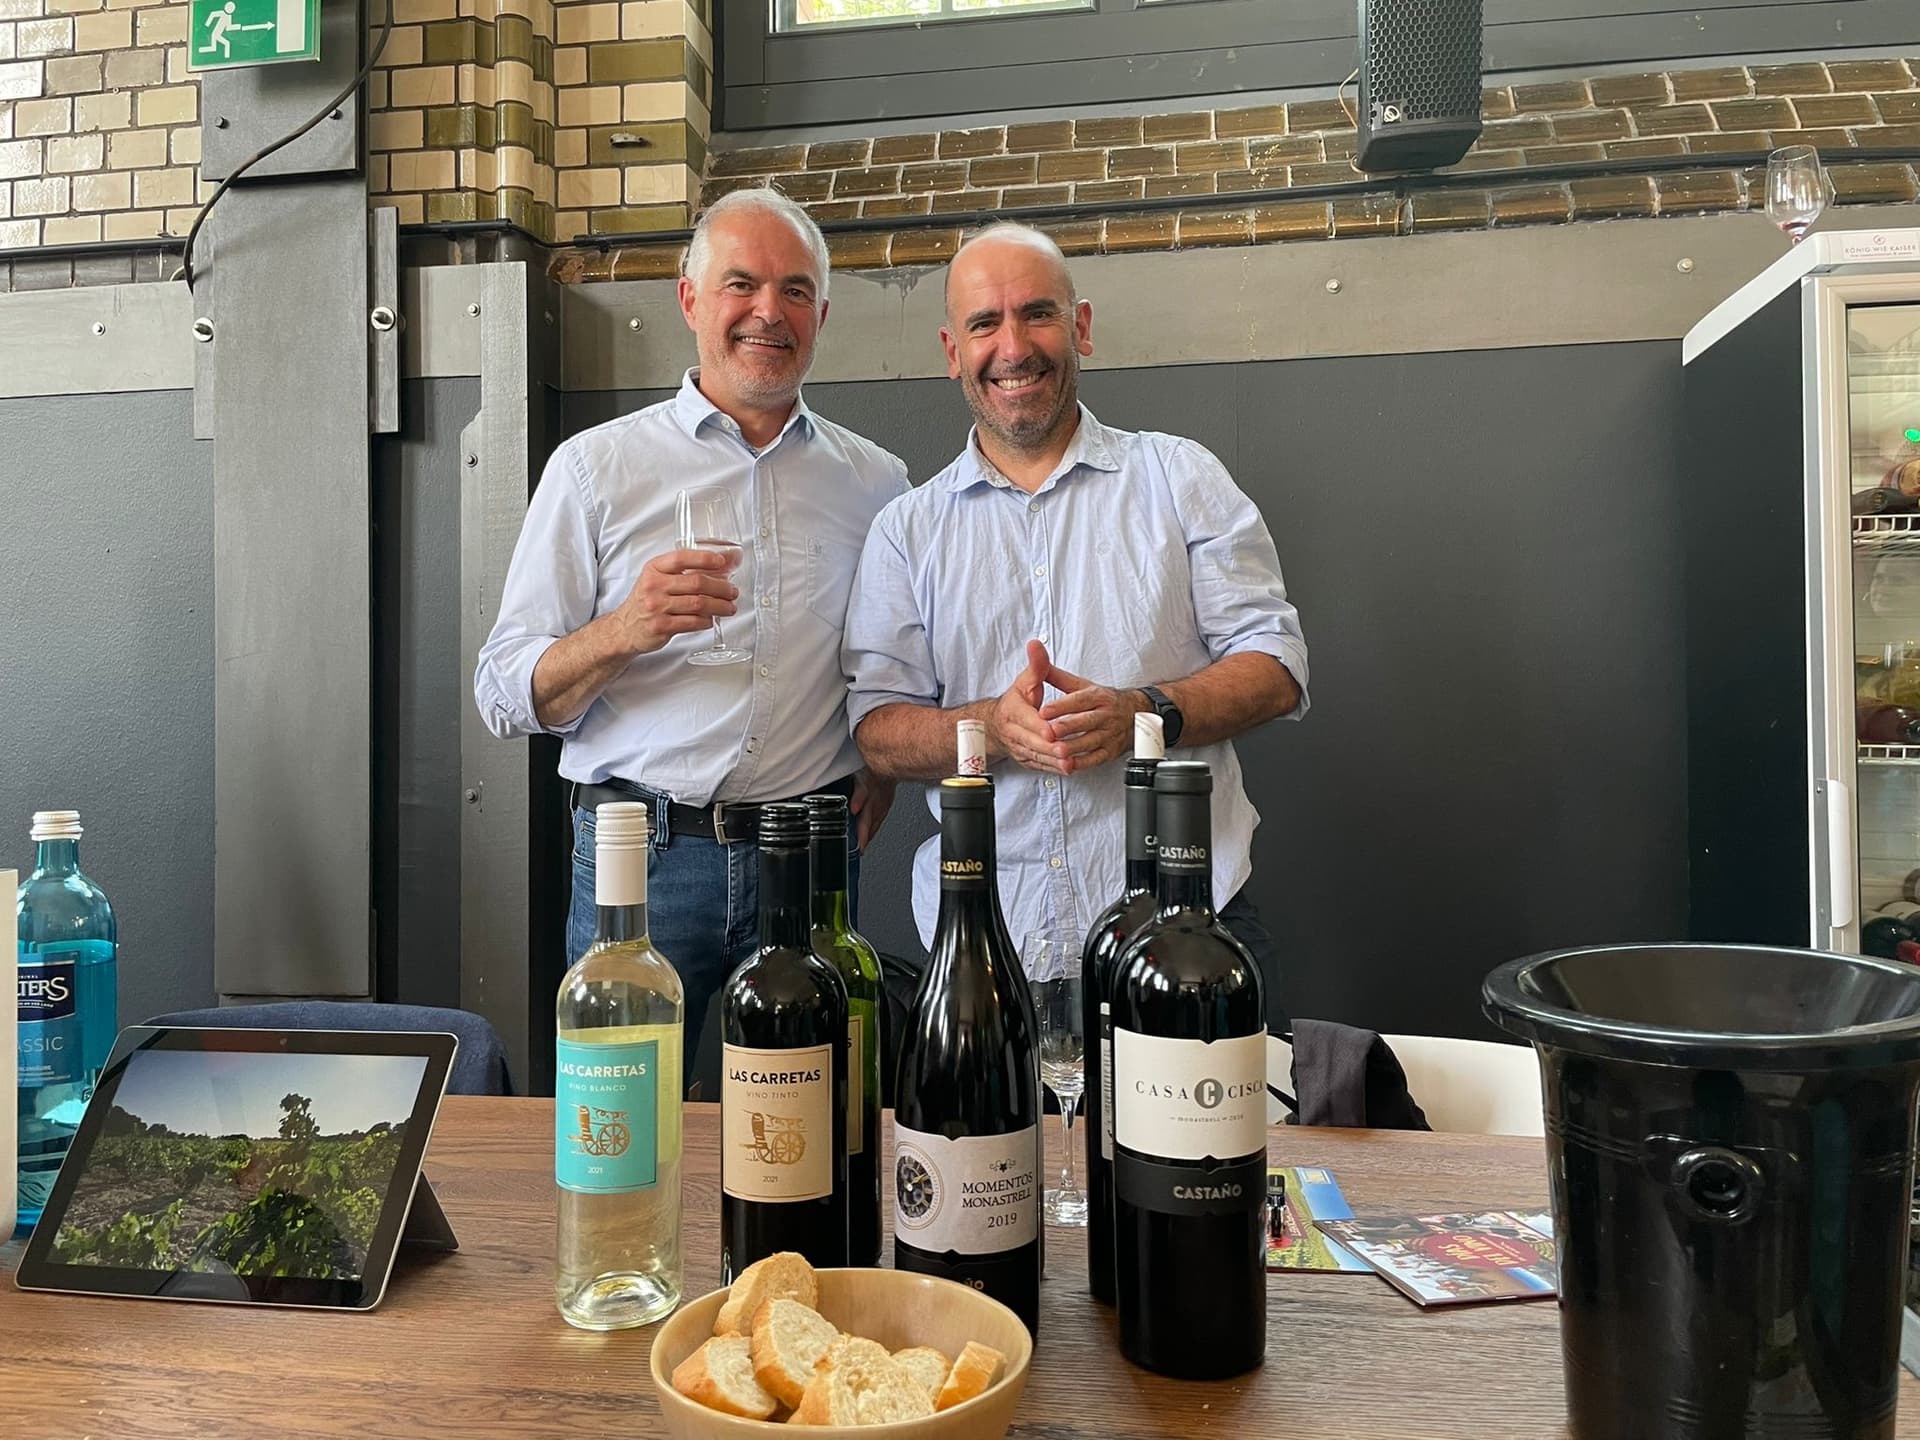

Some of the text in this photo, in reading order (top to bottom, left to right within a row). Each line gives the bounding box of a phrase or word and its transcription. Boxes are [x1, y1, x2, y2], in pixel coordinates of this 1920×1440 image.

[1159, 845, 1207, 859] CASTAÑO
[17, 976, 69, 1002] TERS
[560, 1061, 646, 1078] LAS CARRETAS
[729, 1068, 821, 1085] LAS CARRETAS
[589, 1084, 627, 1092] BLANCO
[746, 1090, 799, 1099] VINO TINTO
[1136, 1080, 1188, 1100] CASA
[961, 1171, 1034, 1194] MOMENTOS
[1172, 1182, 1242, 1200] CASTAÑO
[961, 1188, 1033, 1208] MONASTRELL
[987, 1212, 1018, 1229] 2019
